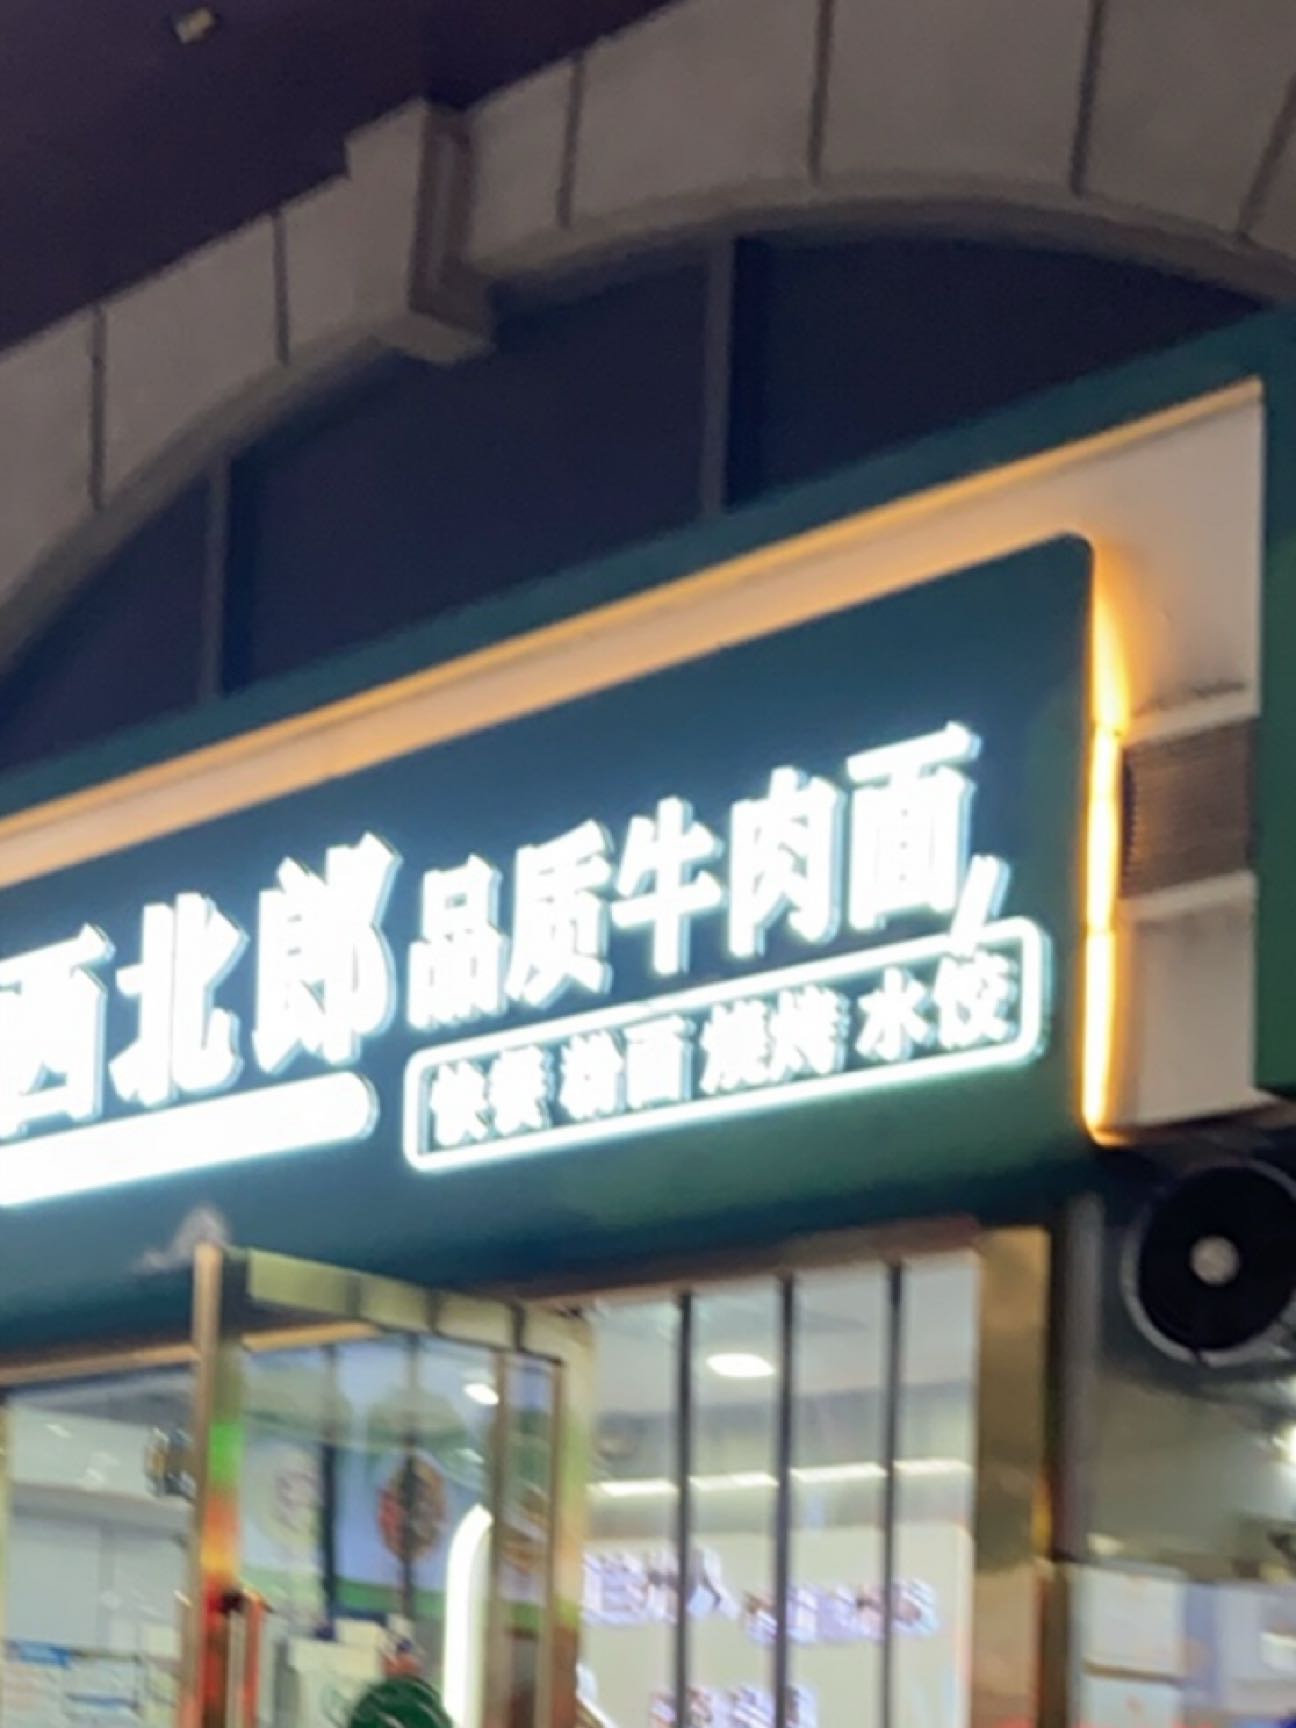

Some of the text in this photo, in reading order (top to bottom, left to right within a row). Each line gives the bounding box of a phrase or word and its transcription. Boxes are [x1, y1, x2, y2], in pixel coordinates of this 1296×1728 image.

[407, 720, 984, 1032] 品质牛肉面
[856, 950, 1018, 1064] 水饺
